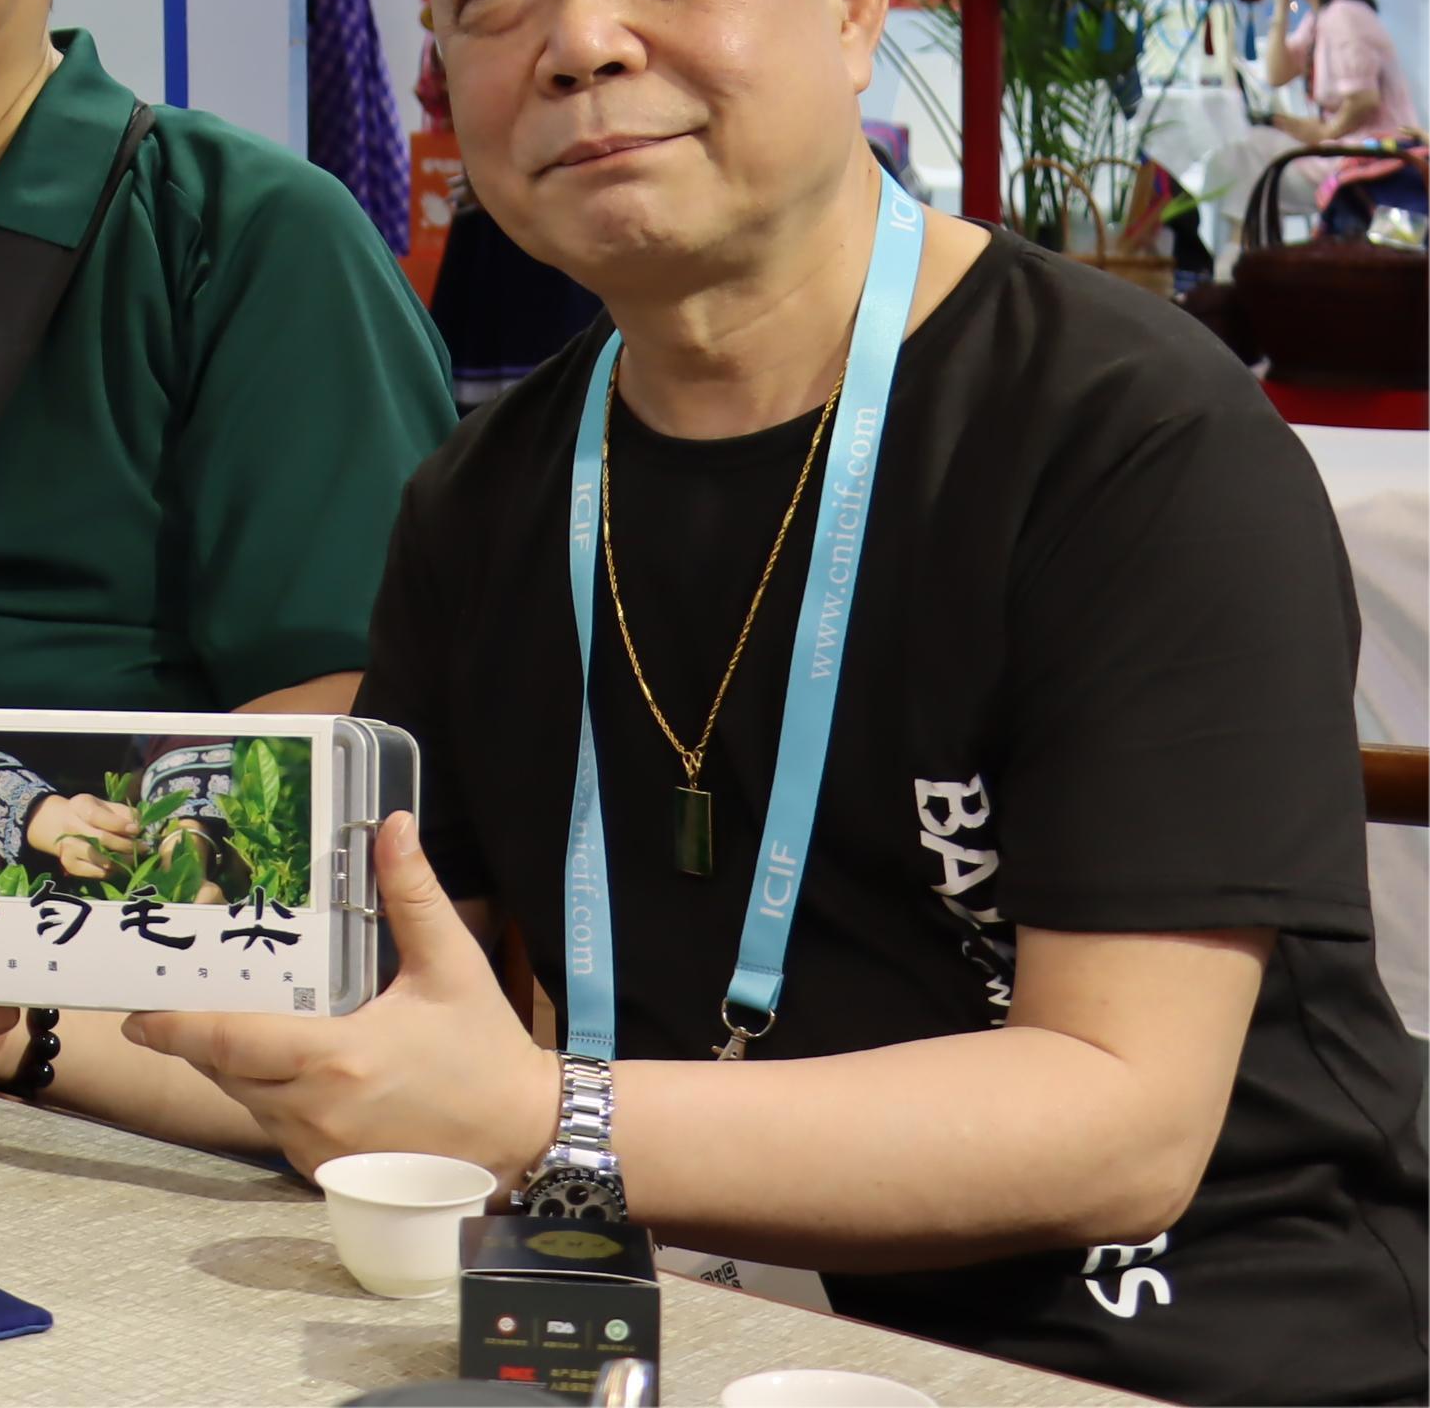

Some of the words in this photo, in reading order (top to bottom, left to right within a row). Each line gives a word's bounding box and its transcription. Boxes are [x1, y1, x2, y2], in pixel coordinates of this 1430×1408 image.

[575, 480, 593, 551] ICIF
[810, 403, 878, 682] www.cnicif.com
[759, 838, 799, 919] ICIF
[154, 965, 294, 984] 都匀毛尖
